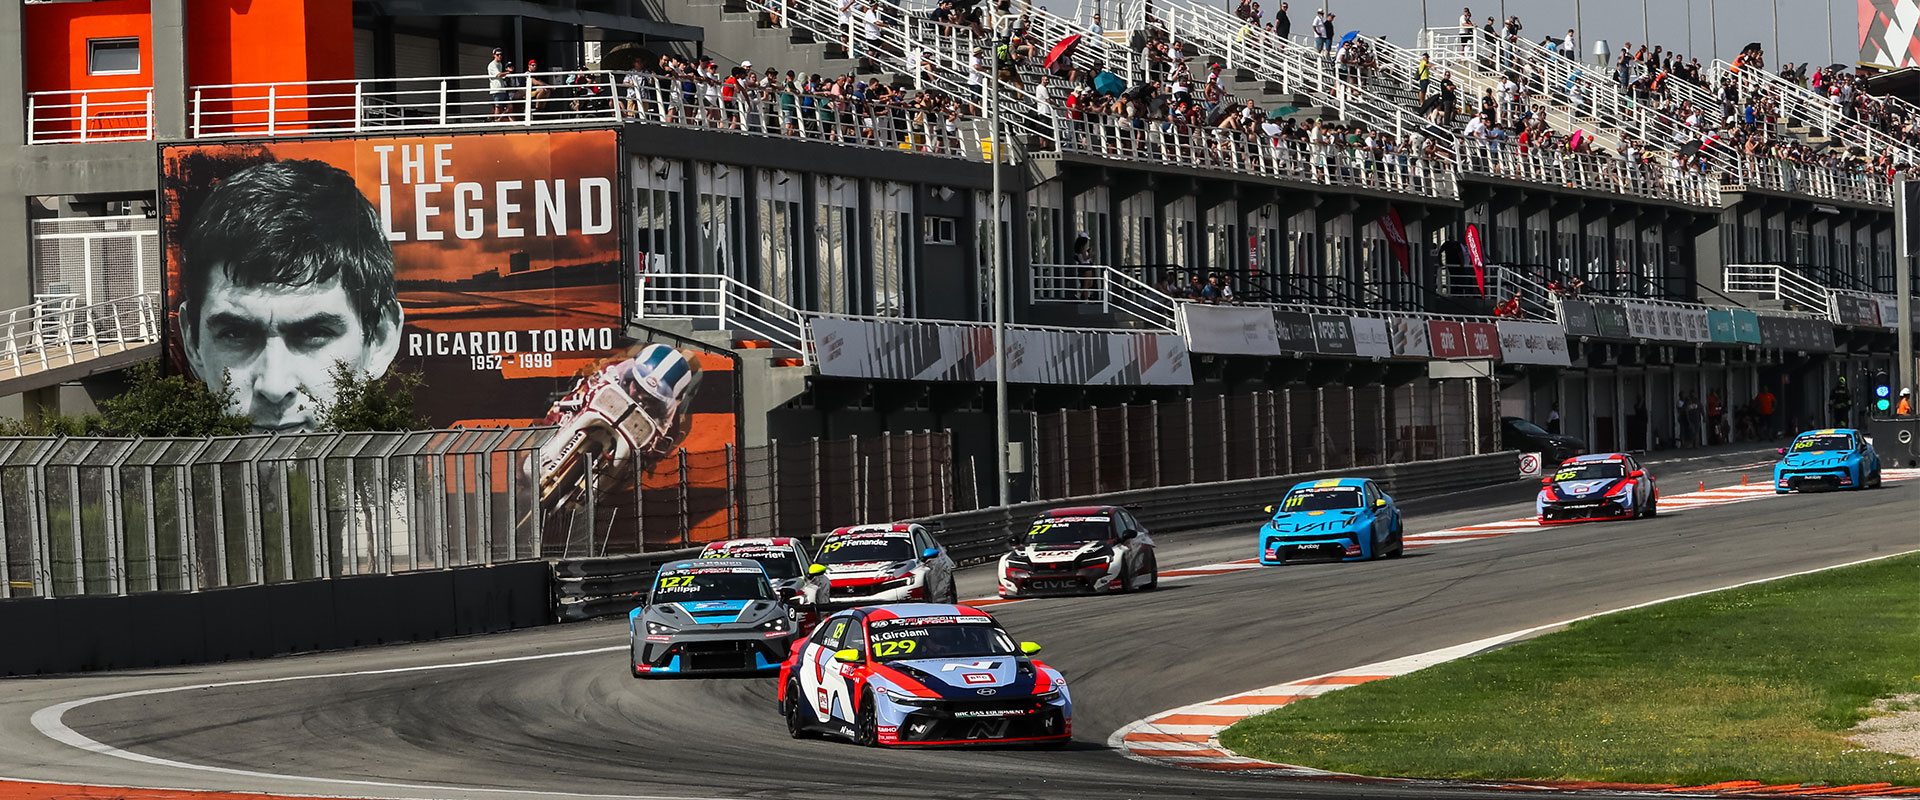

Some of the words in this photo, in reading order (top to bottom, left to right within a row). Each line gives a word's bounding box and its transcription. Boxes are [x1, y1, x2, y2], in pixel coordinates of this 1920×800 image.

[374, 144, 454, 184] THE
[381, 177, 612, 241] LEGEND
[409, 333, 517, 357] RICARDO
[530, 328, 613, 352] TORMO
[470, 355, 502, 371] 1952
[519, 353, 552, 370] 1998
[1794, 441, 1814, 449] 168
[1555, 471, 1577, 481] 105
[1286, 497, 1304, 508] 111
[1028, 524, 1052, 535] 27
[824, 542, 842, 553] 19
[660, 576, 695, 588] 127
[1032, 580, 1078, 590] CIVIC
[870, 629, 929, 642] N.Girolami
[872, 640, 917, 657] 129
